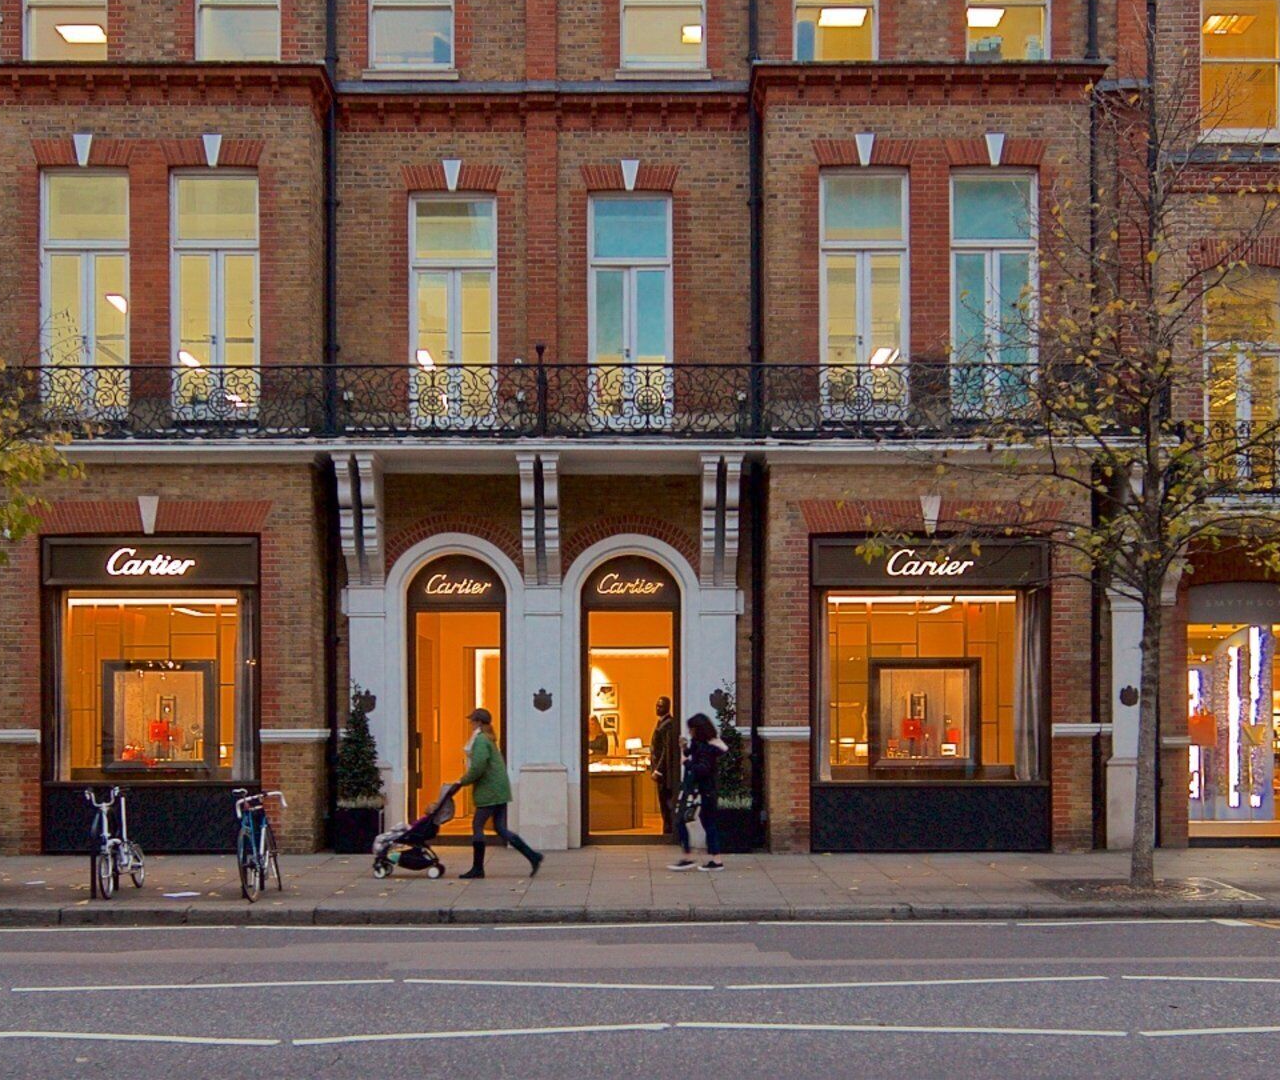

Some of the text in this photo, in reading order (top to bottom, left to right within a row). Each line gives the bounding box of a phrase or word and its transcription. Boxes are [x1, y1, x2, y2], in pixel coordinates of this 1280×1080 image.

[106, 547, 195, 576] Cartier
[886, 548, 974, 576] Cartier
[425, 573, 492, 595] Cartier
[597, 573, 664, 595] Cartier
